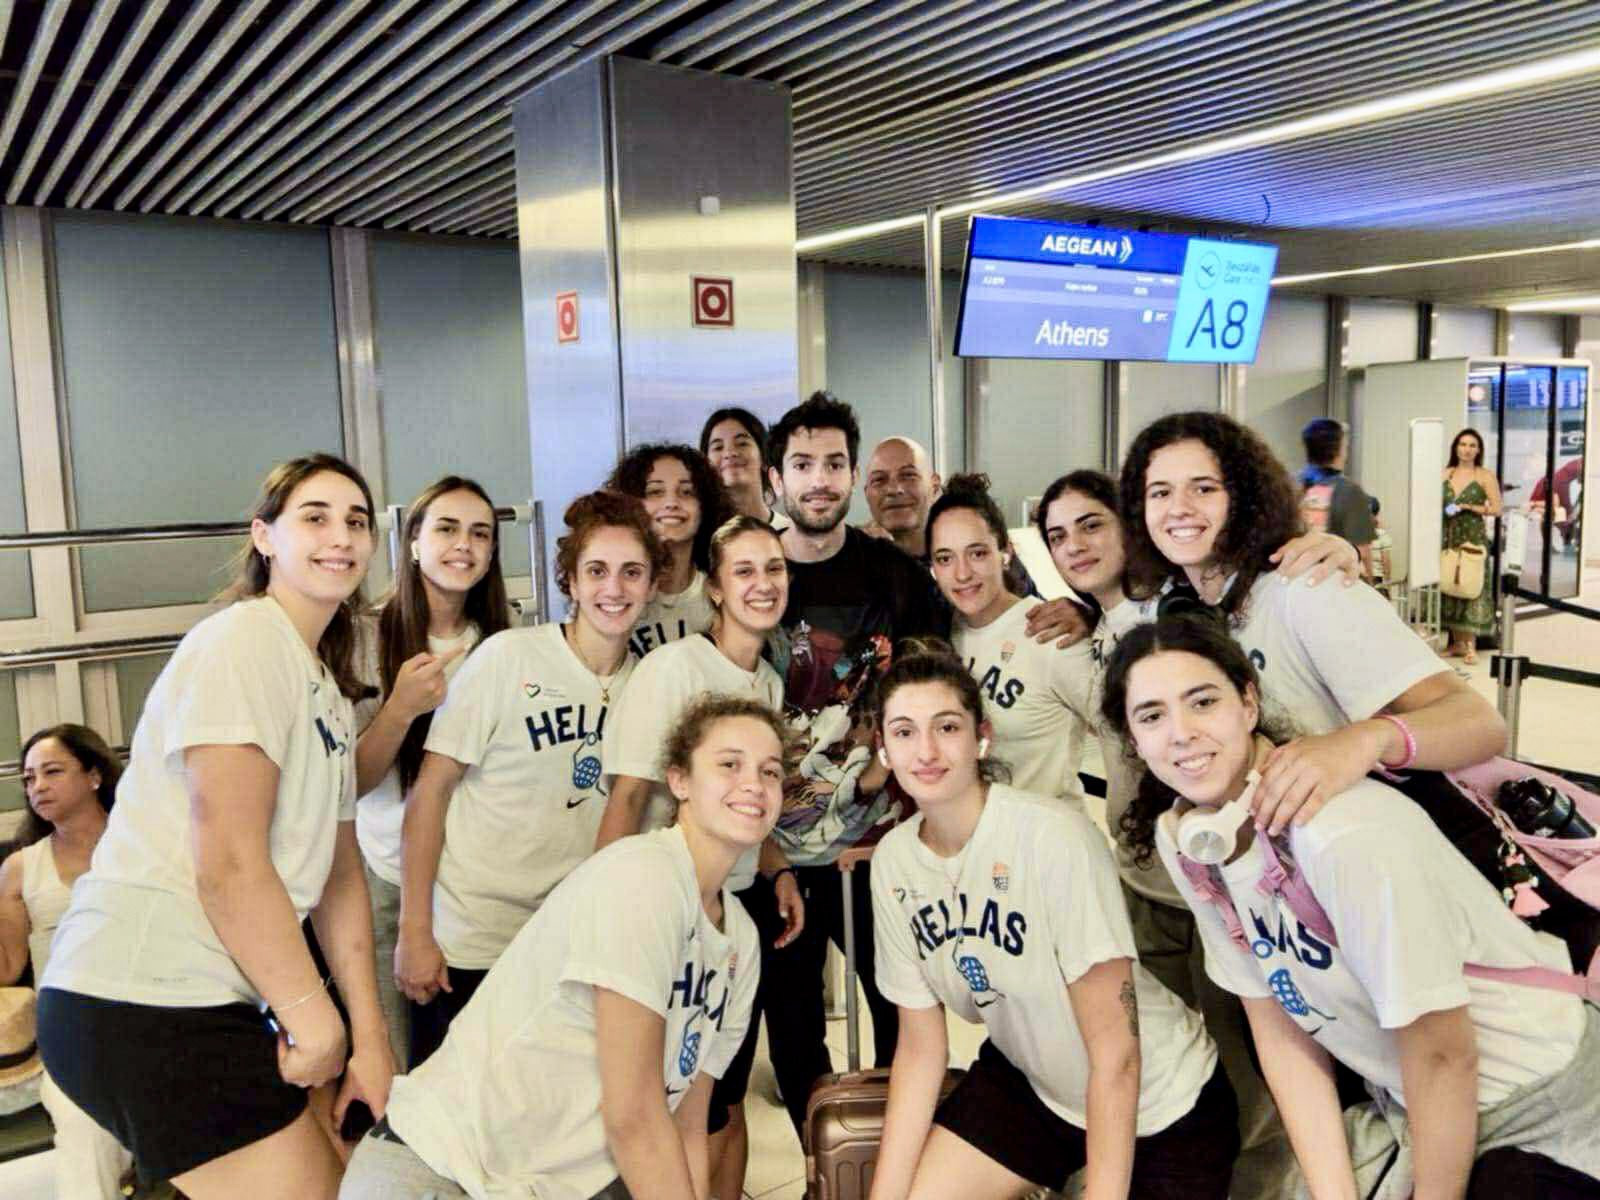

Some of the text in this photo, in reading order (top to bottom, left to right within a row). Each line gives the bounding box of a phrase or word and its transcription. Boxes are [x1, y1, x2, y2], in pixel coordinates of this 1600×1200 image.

[1041, 234, 1117, 257] AEGEAN
[1034, 319, 1109, 347] Athens
[1185, 297, 1249, 350] A8
[909, 893, 1027, 957] HELLAS
